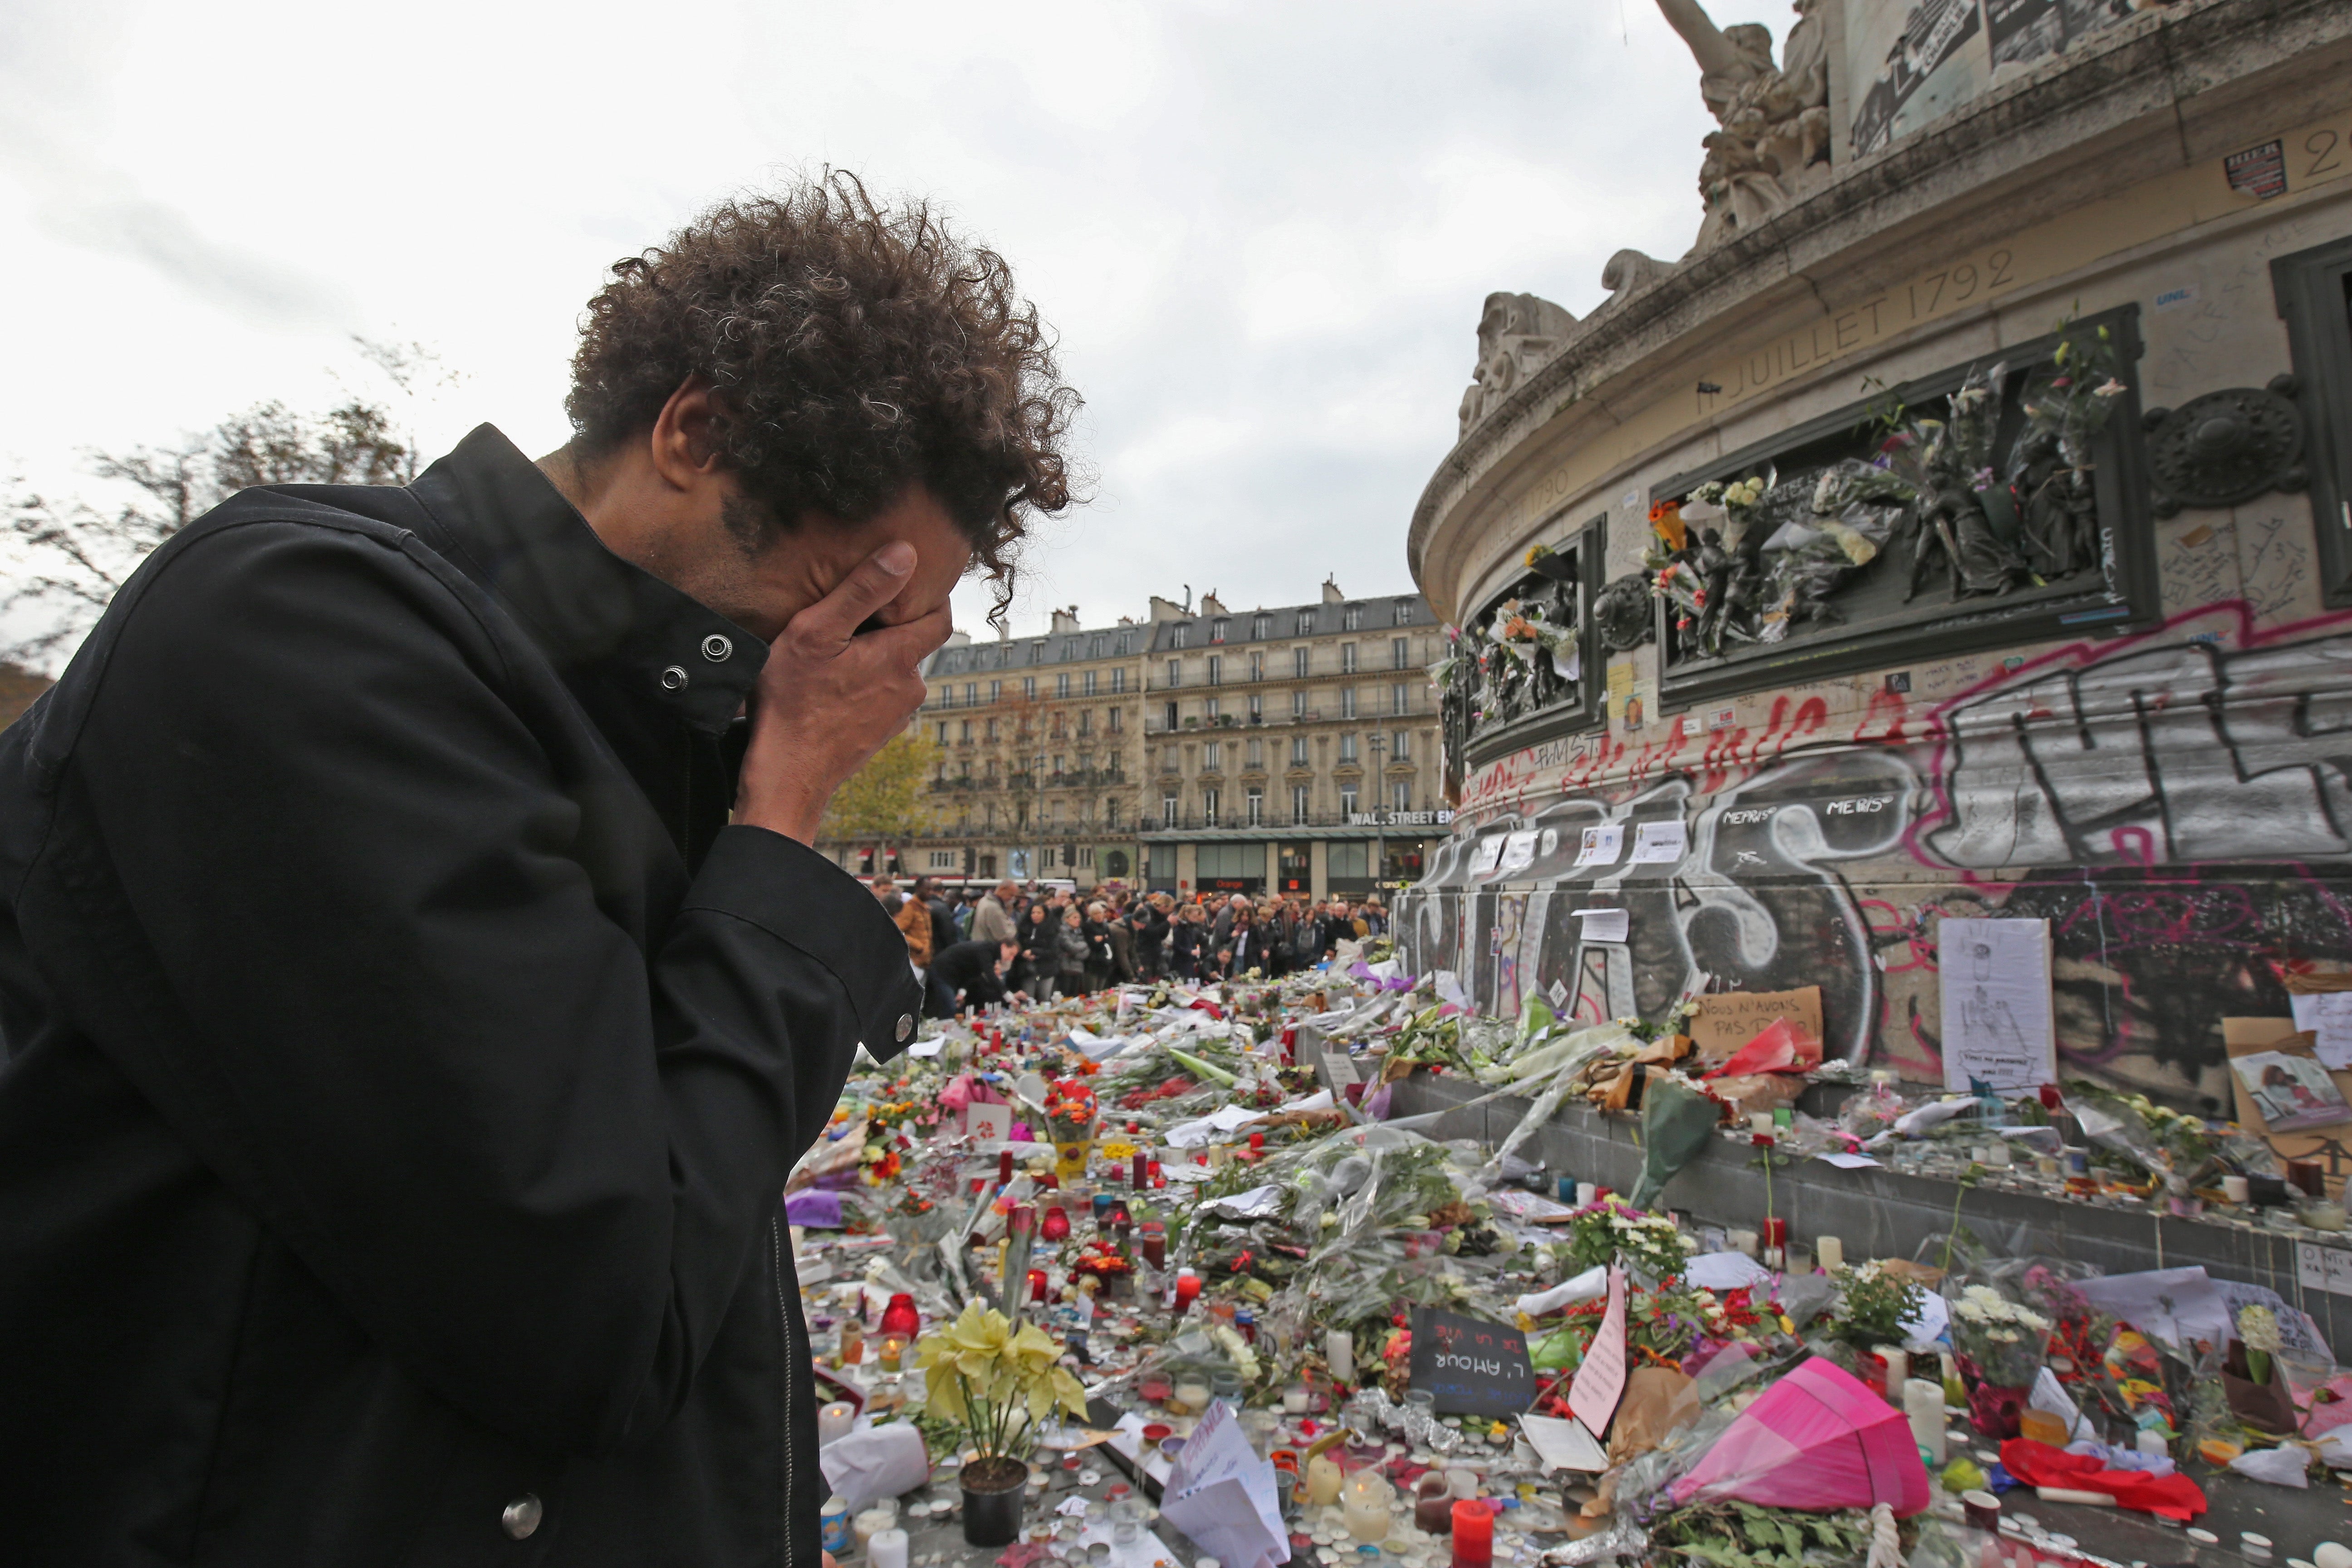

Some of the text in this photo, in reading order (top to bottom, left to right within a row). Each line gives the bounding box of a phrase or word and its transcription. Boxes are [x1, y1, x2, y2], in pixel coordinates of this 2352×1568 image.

[2304, 130, 2352, 178] 2
[1729, 288, 1890, 398] JUILLET
[1908, 250, 2014, 319] 1792
[1532, 469, 1568, 515] 1790
[1388, 811, 1433, 825] STREET
[1715, 1020, 1746, 1036] PAS
[1475, 1333, 1493, 1347] LA
